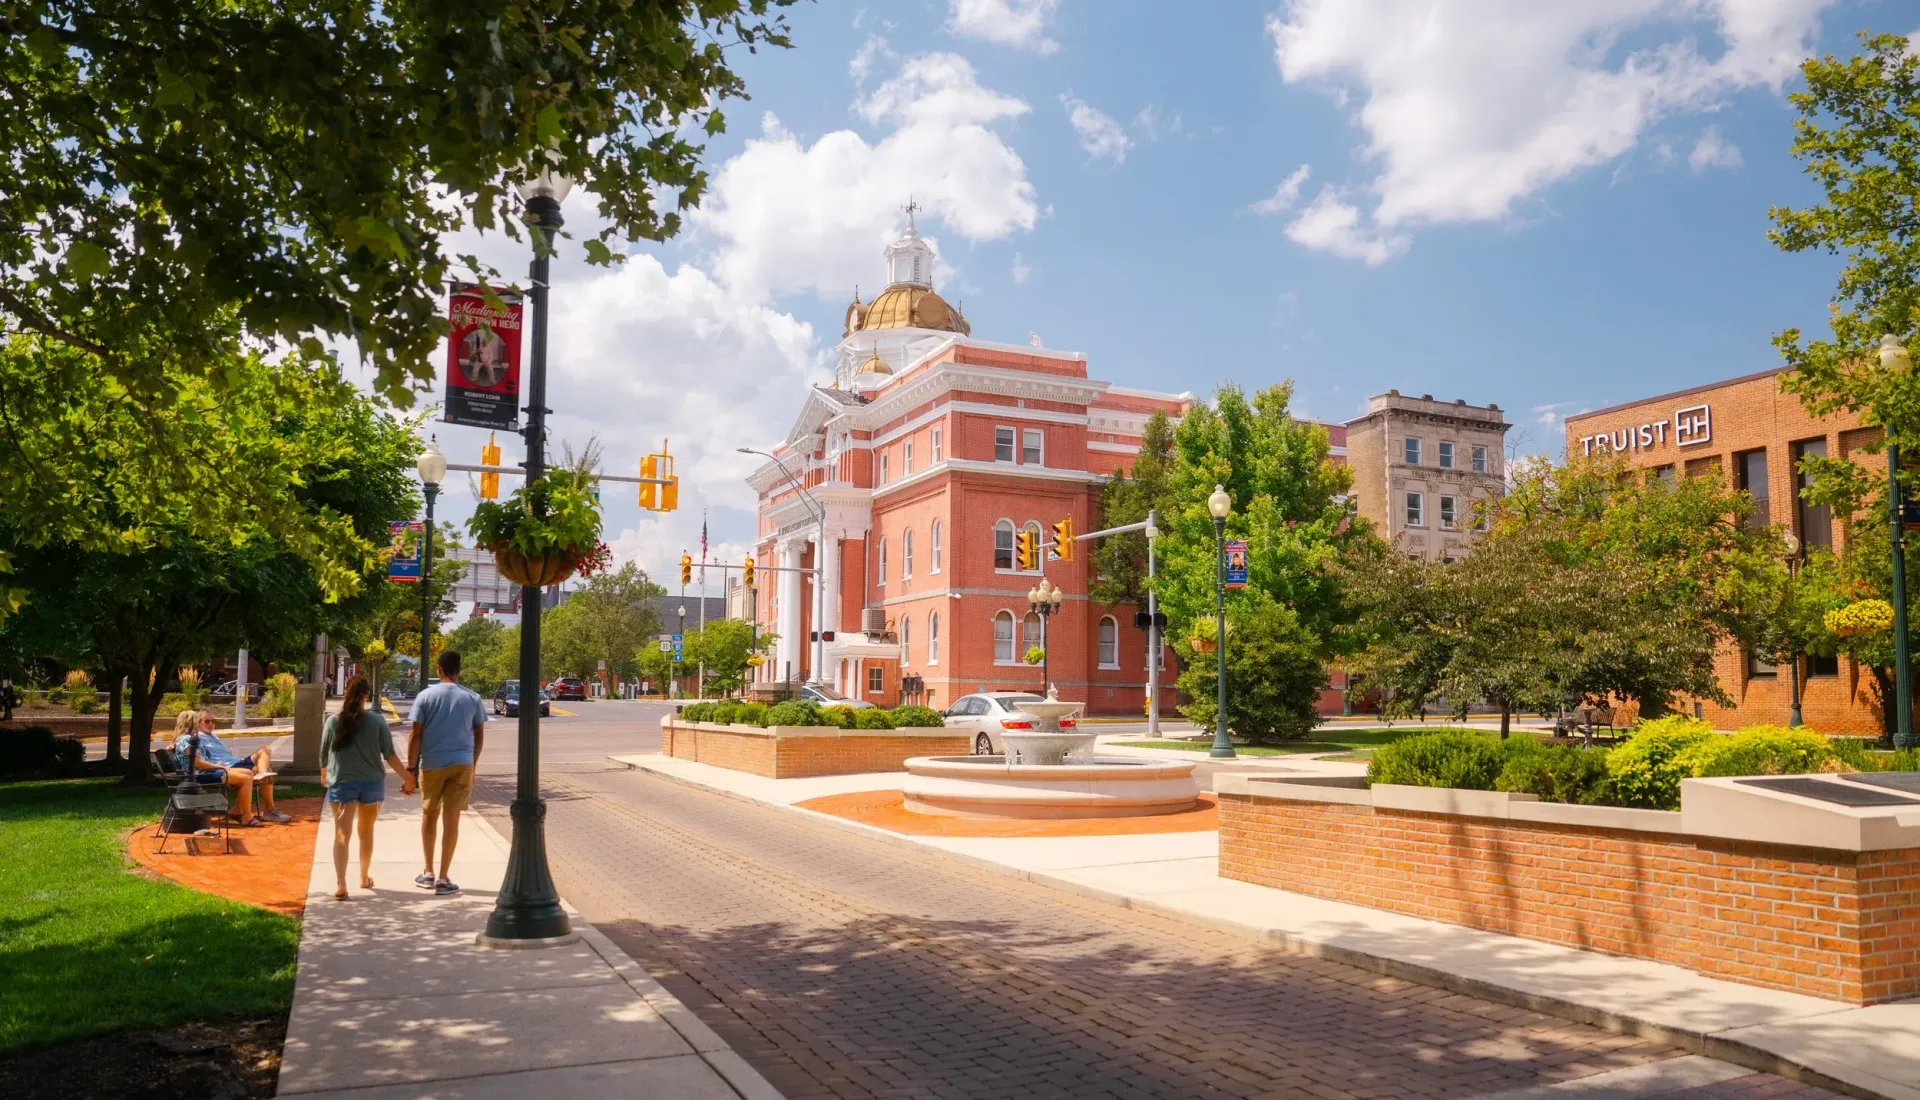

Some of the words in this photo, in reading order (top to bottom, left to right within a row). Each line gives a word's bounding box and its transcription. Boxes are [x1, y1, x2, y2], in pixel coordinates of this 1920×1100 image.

[499, 319, 520, 330] HERO
[464, 391, 485, 399] ROBERT
[1579, 420, 1669, 457] TRUIST
